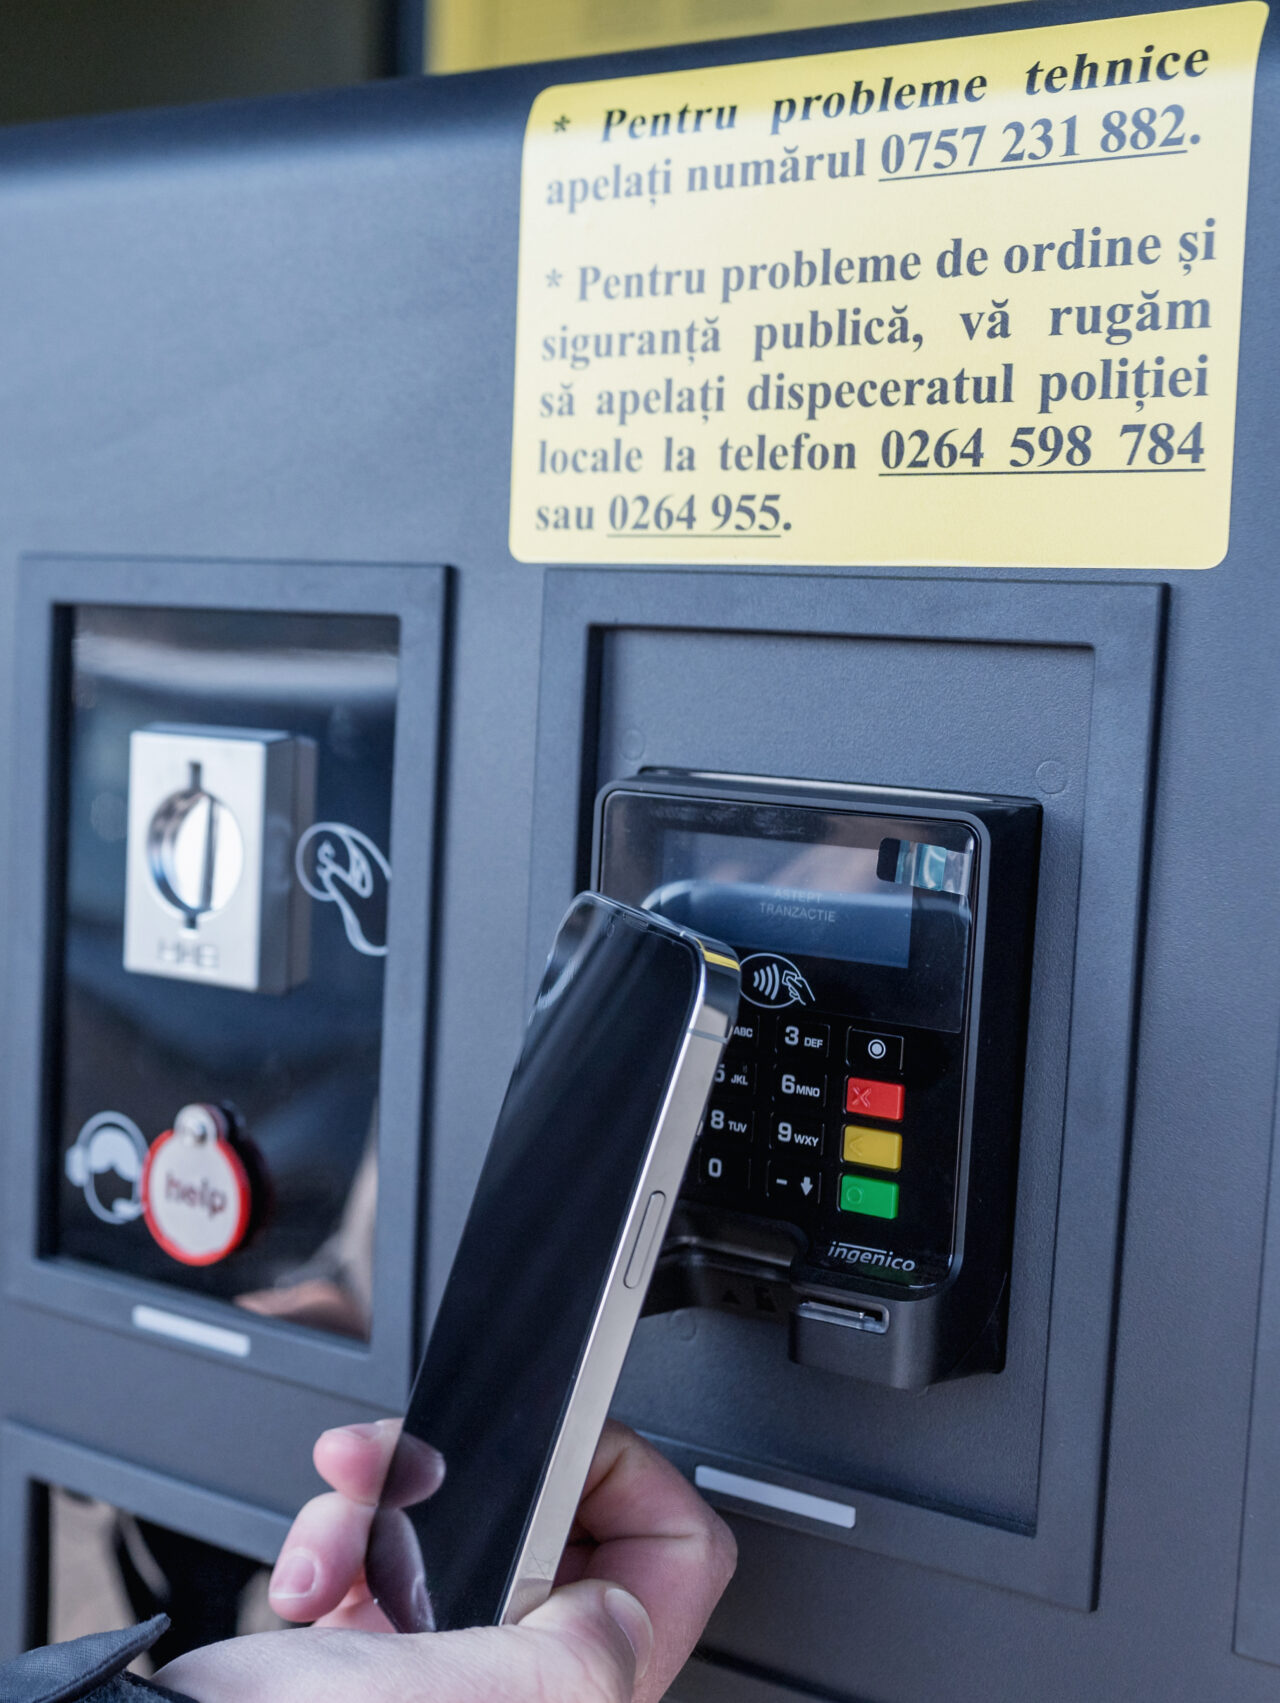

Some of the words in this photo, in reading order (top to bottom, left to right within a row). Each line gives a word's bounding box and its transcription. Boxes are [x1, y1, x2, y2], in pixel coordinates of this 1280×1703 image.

[600, 103, 739, 143] Pentru
[770, 75, 988, 136] probleme
[1025, 44, 1210, 96] tehnice
[546, 157, 672, 215] apelați
[686, 138, 867, 193] numărul
[880, 124, 987, 176] 0757
[1001, 114, 1081, 164] 231
[1099, 103, 1201, 155] 882.
[576, 263, 707, 302] Pentru
[721, 248, 922, 303] probleme
[936, 237, 988, 278] de
[1003, 226, 1162, 274] ordine
[1178, 217, 1216, 276] și
[541, 315, 722, 370] siguranță
[753, 304, 924, 362] publică,
[959, 298, 1012, 341] vă
[1048, 289, 1212, 345] rugăm
[539, 381, 576, 419] să
[596, 375, 726, 426] apelați
[747, 363, 1015, 421] dispeceratul
[1037, 354, 1209, 414] poliției
[538, 437, 644, 475] locale
[663, 436, 697, 472] la
[719, 432, 857, 472] telefon
[880, 427, 985, 470] 0264
[1009, 424, 1093, 469] 598
[1119, 421, 1206, 467] 784
[535, 503, 595, 531] sau
[608, 494, 697, 532] 0264
[710, 493, 793, 532] 955.
[760, 902, 836, 923] TRANZACTIE
[733, 1026, 753, 1038] ABC
[784, 1025, 800, 1046] 3
[804, 1037, 824, 1048] DEF
[730, 1073, 749, 1086] JKL
[781, 1074, 795, 1094] 6
[795, 1085, 820, 1098] MNO
[710, 1109, 724, 1130] 8
[728, 1120, 748, 1134] TUV
[777, 1121, 792, 1142] 9
[793, 1133, 820, 1147] WXY
[708, 1157, 722, 1178] 0
[164, 1168, 228, 1220] help
[827, 1241, 916, 1272] ingenico
